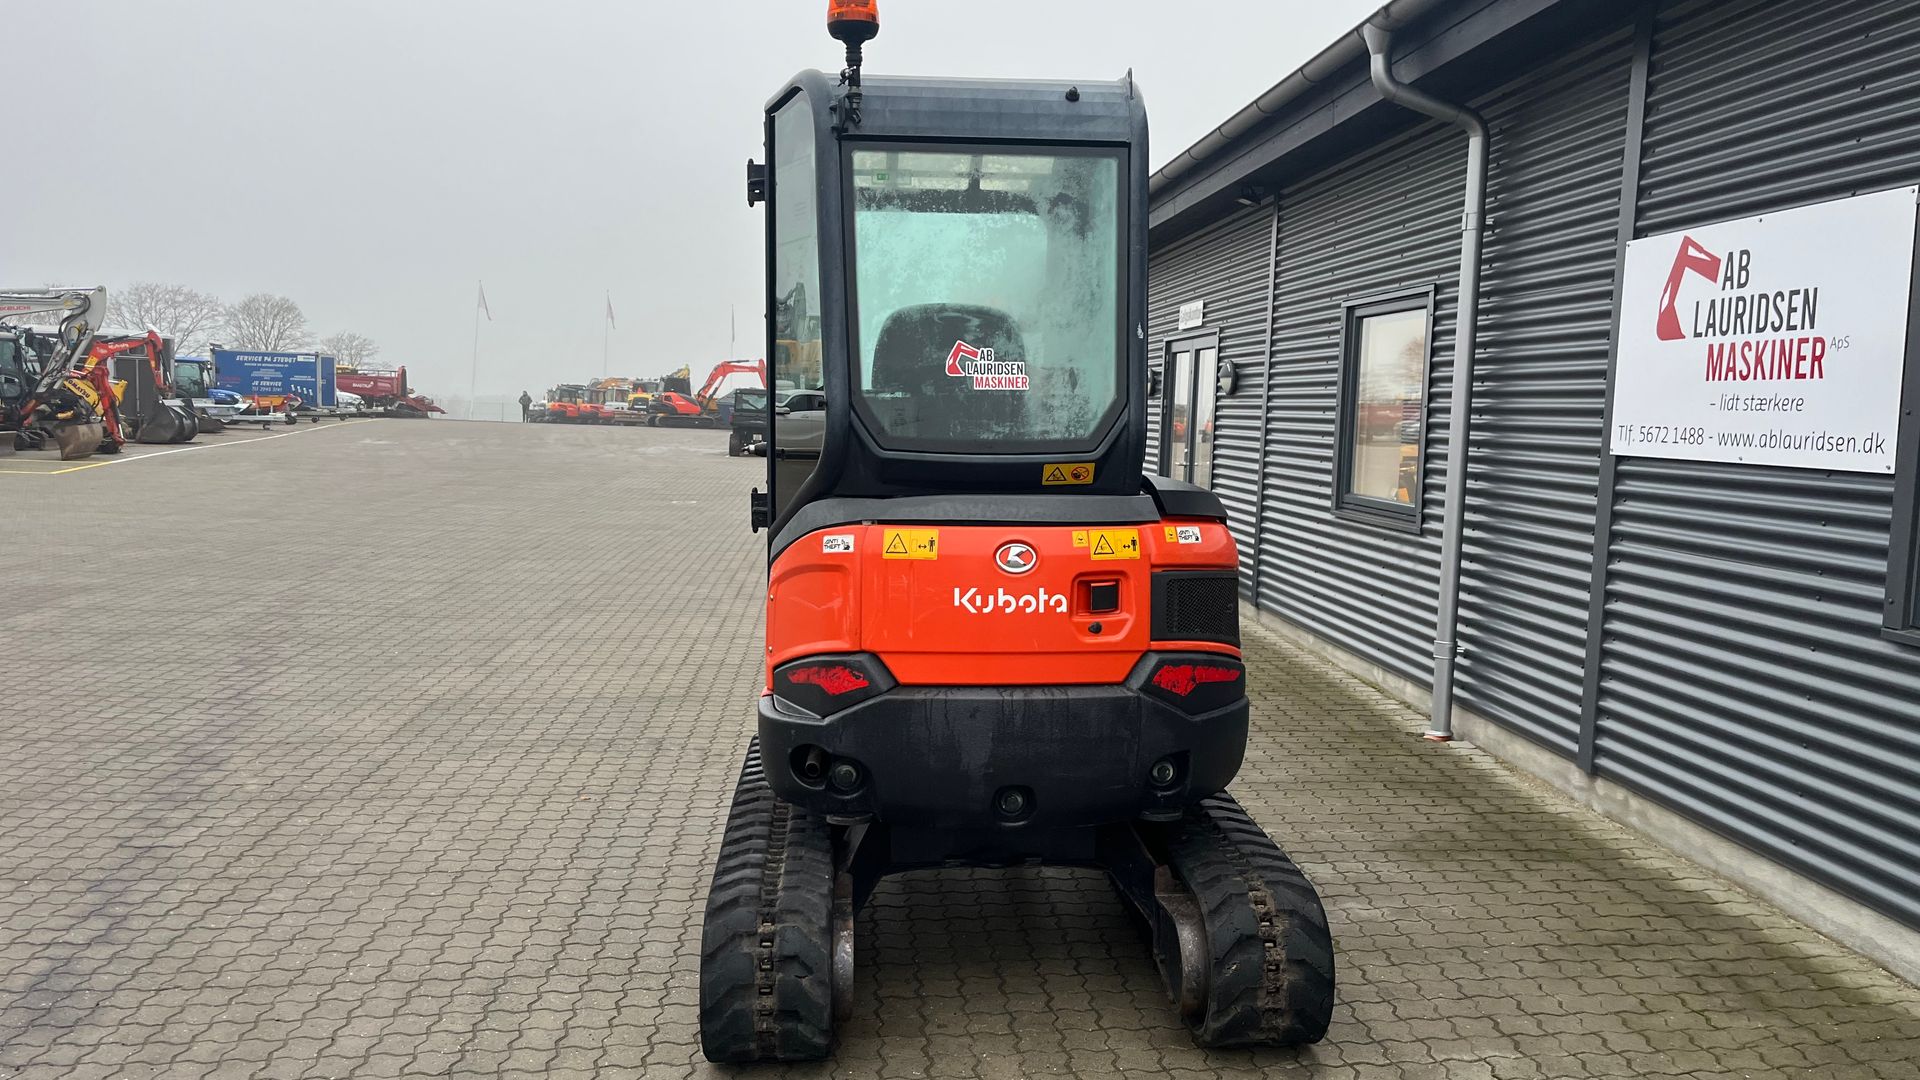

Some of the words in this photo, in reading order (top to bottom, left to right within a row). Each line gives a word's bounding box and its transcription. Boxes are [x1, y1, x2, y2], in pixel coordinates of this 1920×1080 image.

[1721, 249, 1751, 291] AB
[1693, 287, 1818, 338] LAURIDSEN
[980, 349, 993, 361] AB
[1705, 336, 1826, 382] MASKINER
[1830, 335, 1850, 352] ApS
[967, 363, 1023, 375] LAURIDSEN
[68, 380, 90, 398] OMATSU
[975, 376, 1028, 389] MASKINER
[1719, 393, 1740, 411] lidt
[1742, 393, 1805, 412] stærkere
[1618, 425, 1635, 446] Tlf.
[1639, 425, 1668, 444] 5672
[1672, 426, 1704, 445] 1488
[1717, 429, 1886, 455] www.ablauridsen.dk
[953, 587, 1068, 614] Kubota
